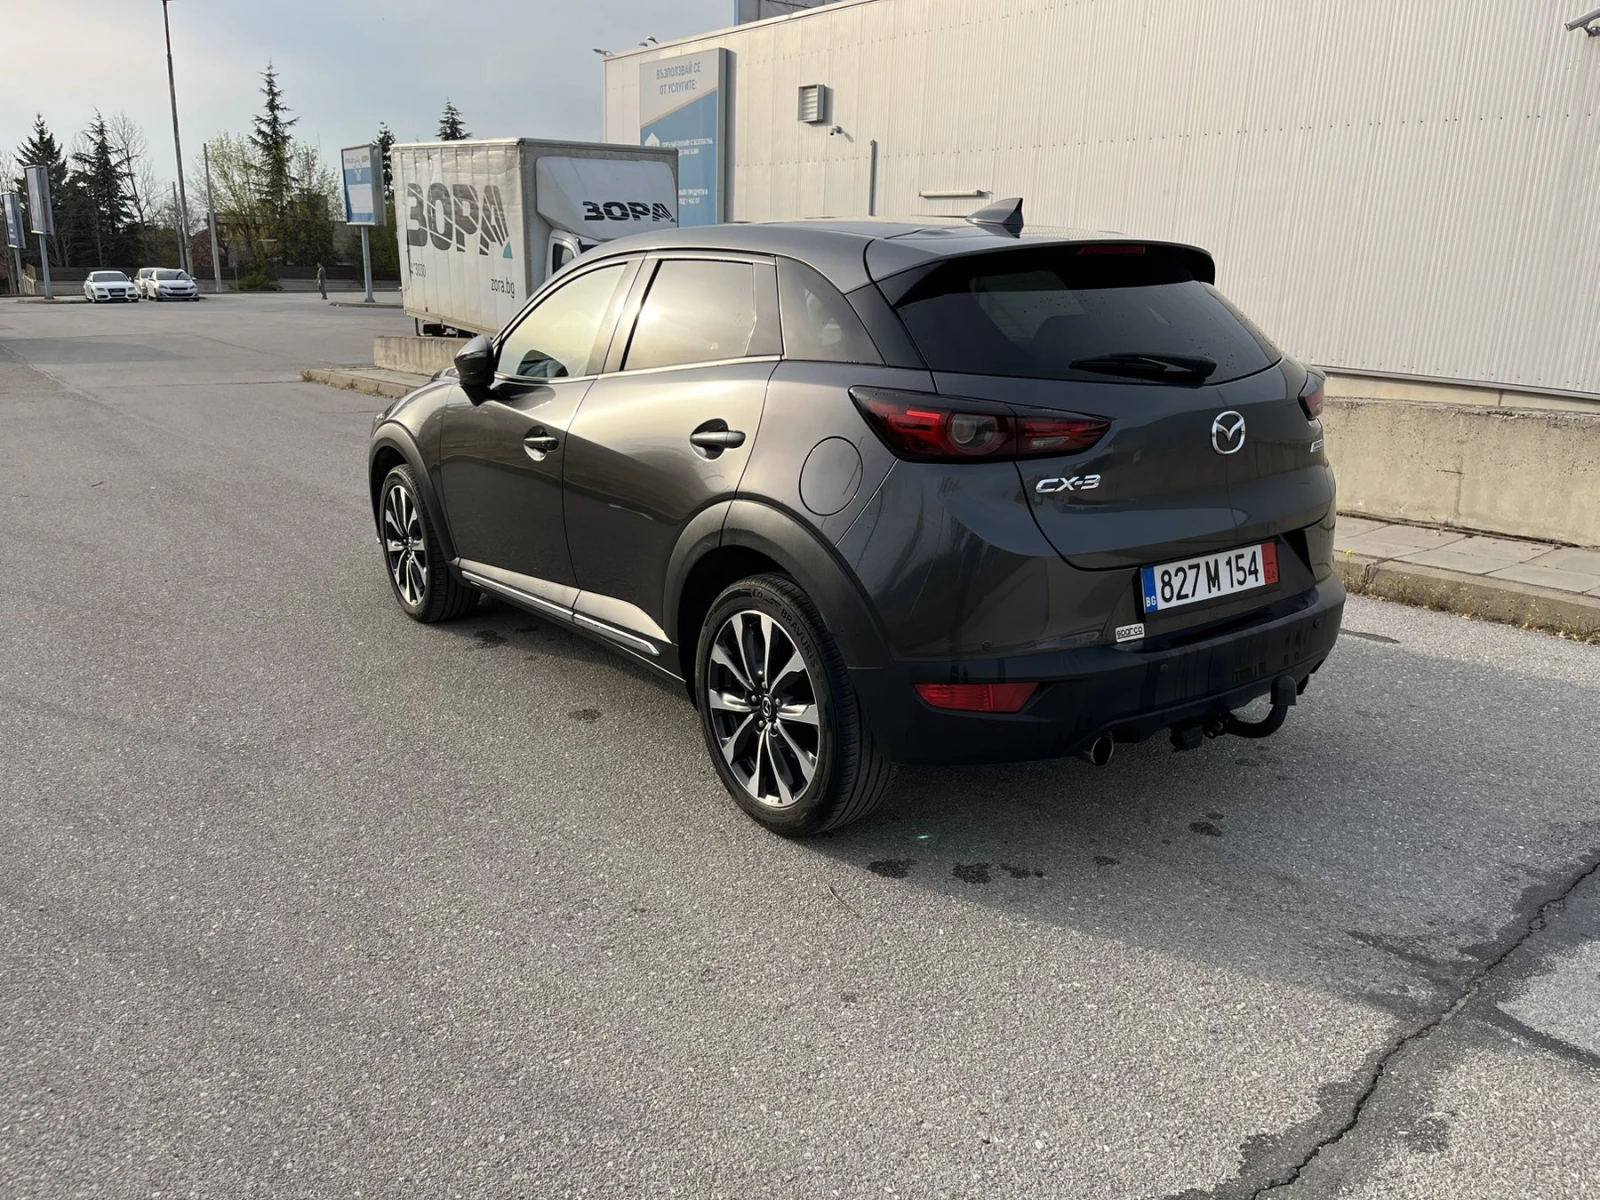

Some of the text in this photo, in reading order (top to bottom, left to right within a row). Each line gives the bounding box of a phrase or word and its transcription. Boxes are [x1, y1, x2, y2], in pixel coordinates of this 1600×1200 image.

[407, 183, 511, 257] ЗОРА
[582, 201, 675, 223] ЗОРА
[490, 277, 515, 299] zora.bg
[1035, 474, 1101, 493] CX-3
[1160, 551, 1260, 604] 827 M 154
[1145, 596, 1157, 607] BG
[780, 607, 818, 669] BRAVURIS
[1116, 625, 1143, 640] sparco
